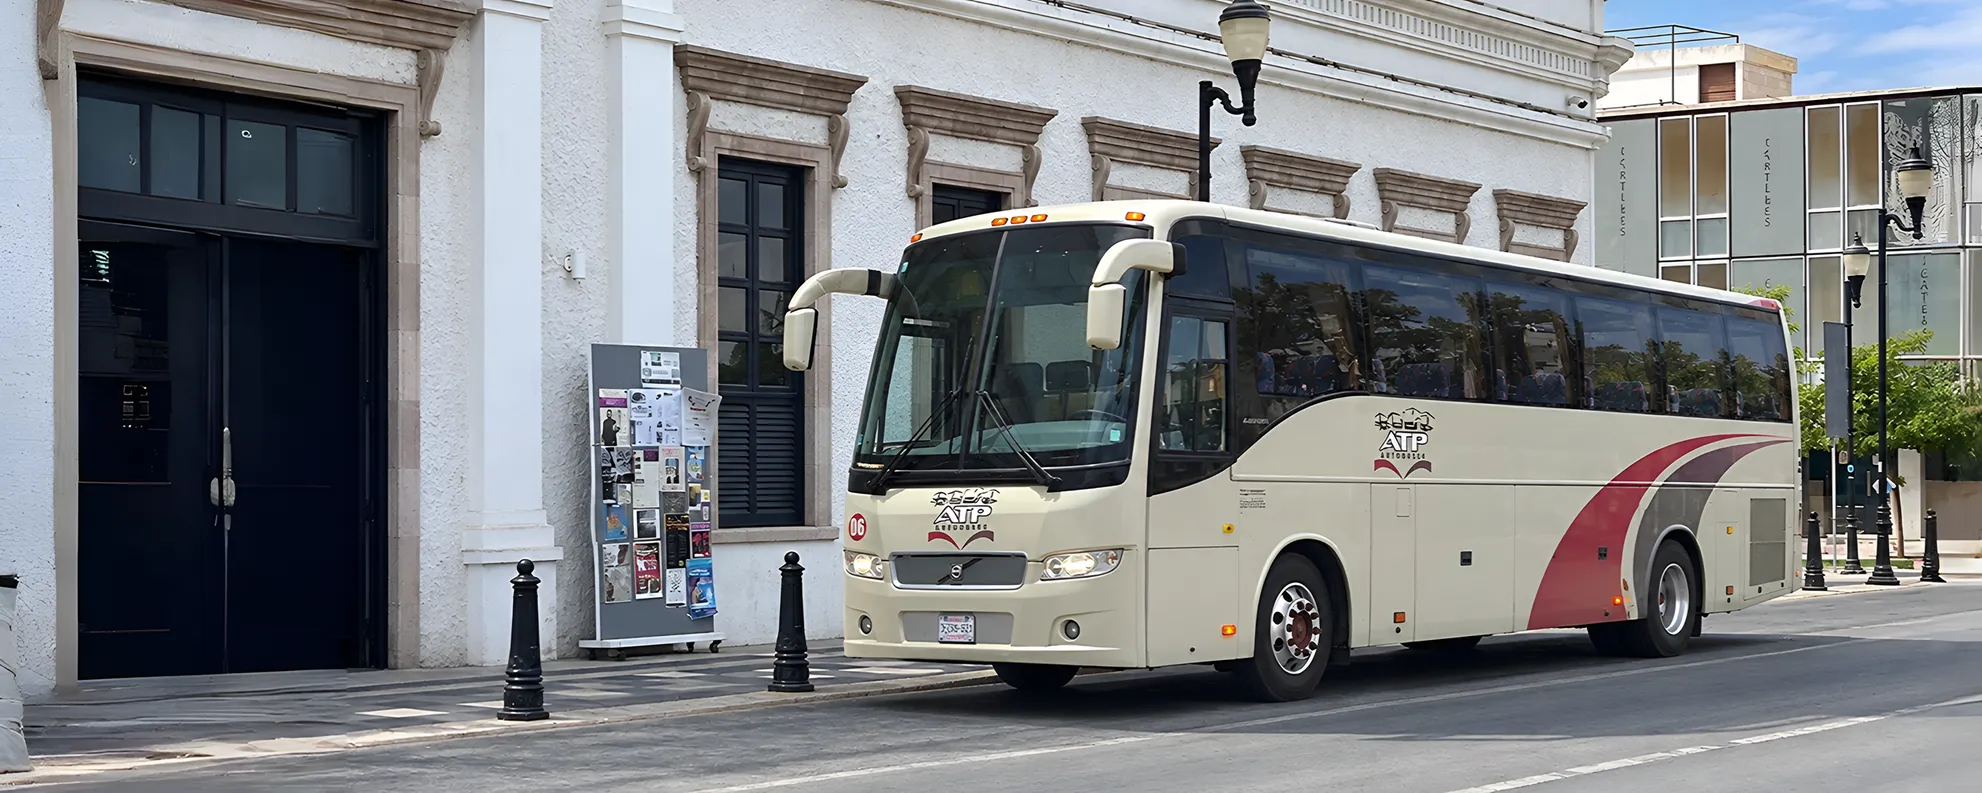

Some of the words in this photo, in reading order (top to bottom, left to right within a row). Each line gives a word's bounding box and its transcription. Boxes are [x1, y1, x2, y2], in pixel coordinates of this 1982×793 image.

[1378, 430, 1429, 453] ATP
[933, 504, 993, 524] ATP
[850, 517, 865, 536] 06
